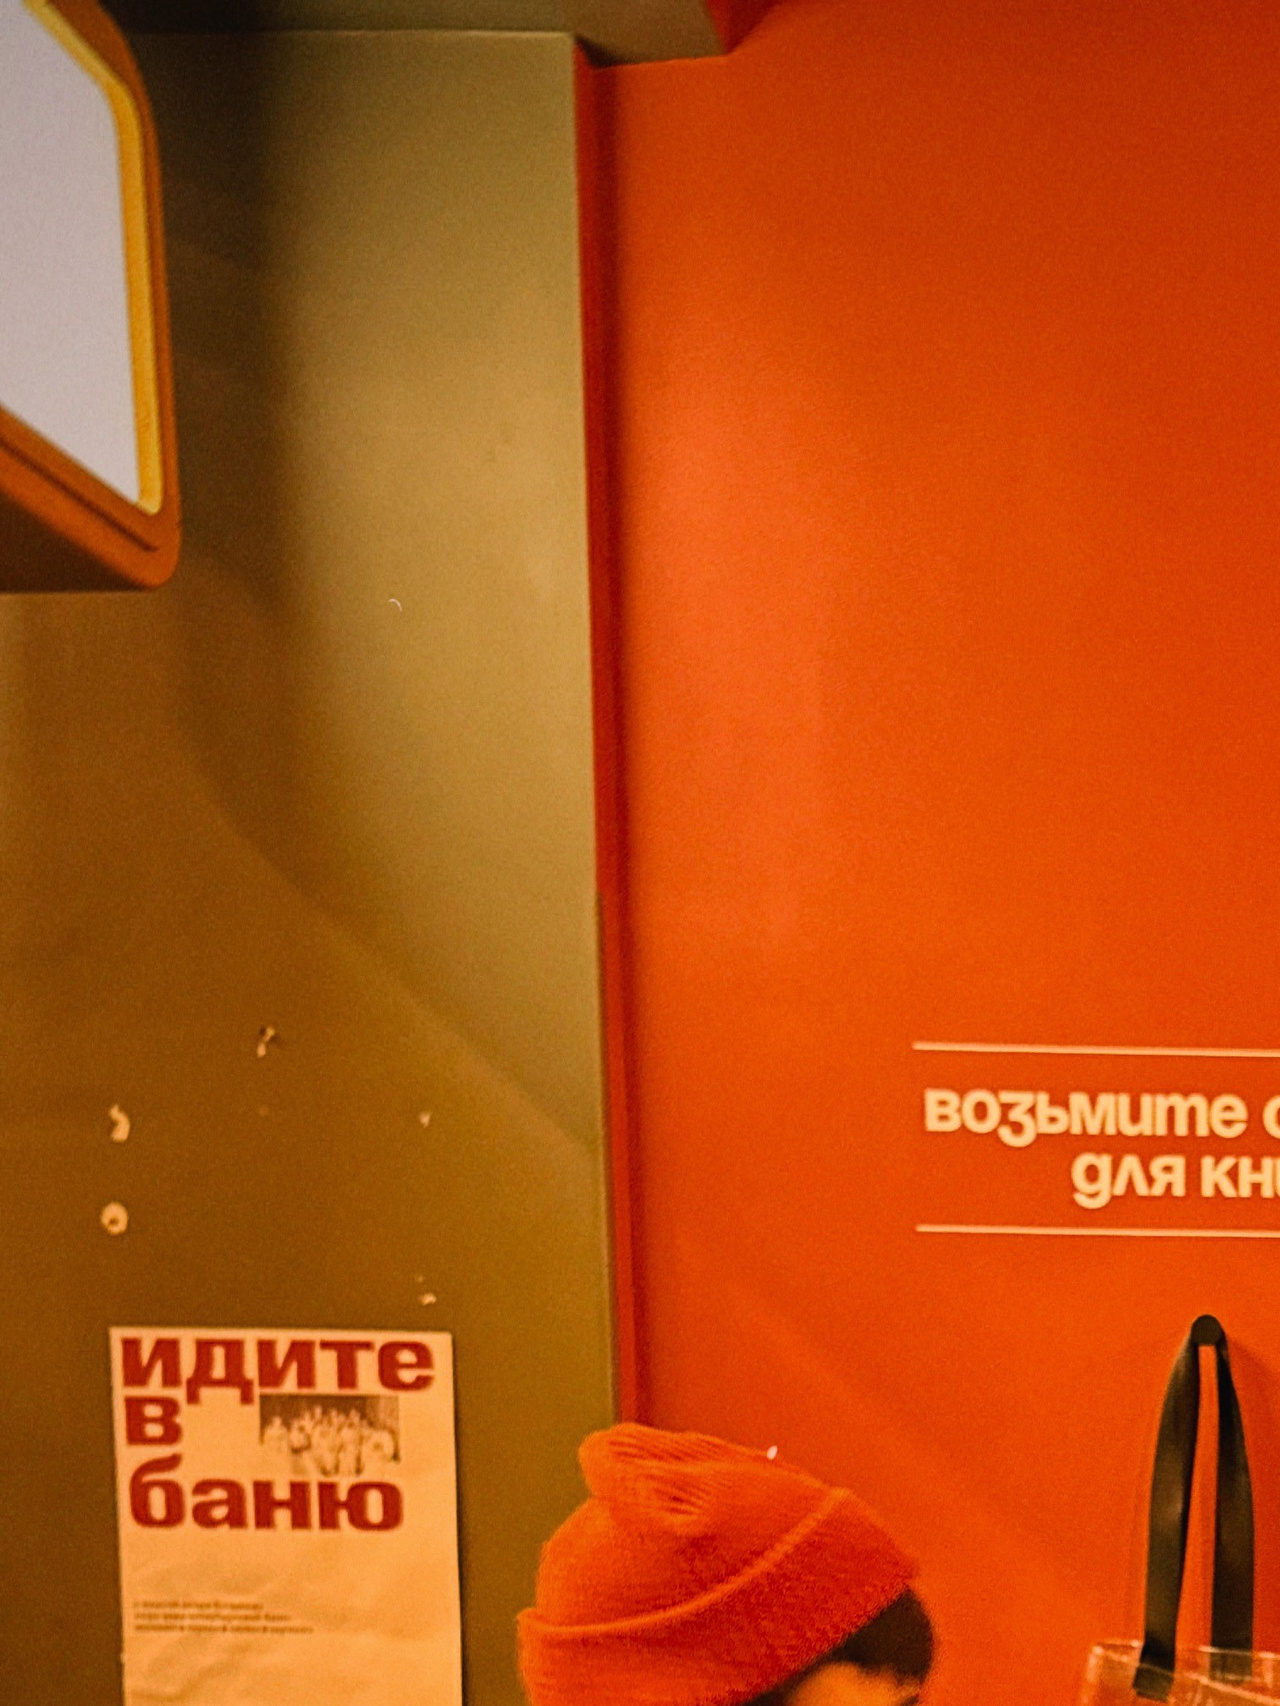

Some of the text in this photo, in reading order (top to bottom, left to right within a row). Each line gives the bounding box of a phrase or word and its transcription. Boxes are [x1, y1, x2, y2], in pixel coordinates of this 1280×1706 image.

[924, 1088, 1248, 1147] возьмите
[1072, 1152, 1186, 1209] для
[121, 1337, 435, 1405] идите
[130, 1453, 404, 1531] баню
